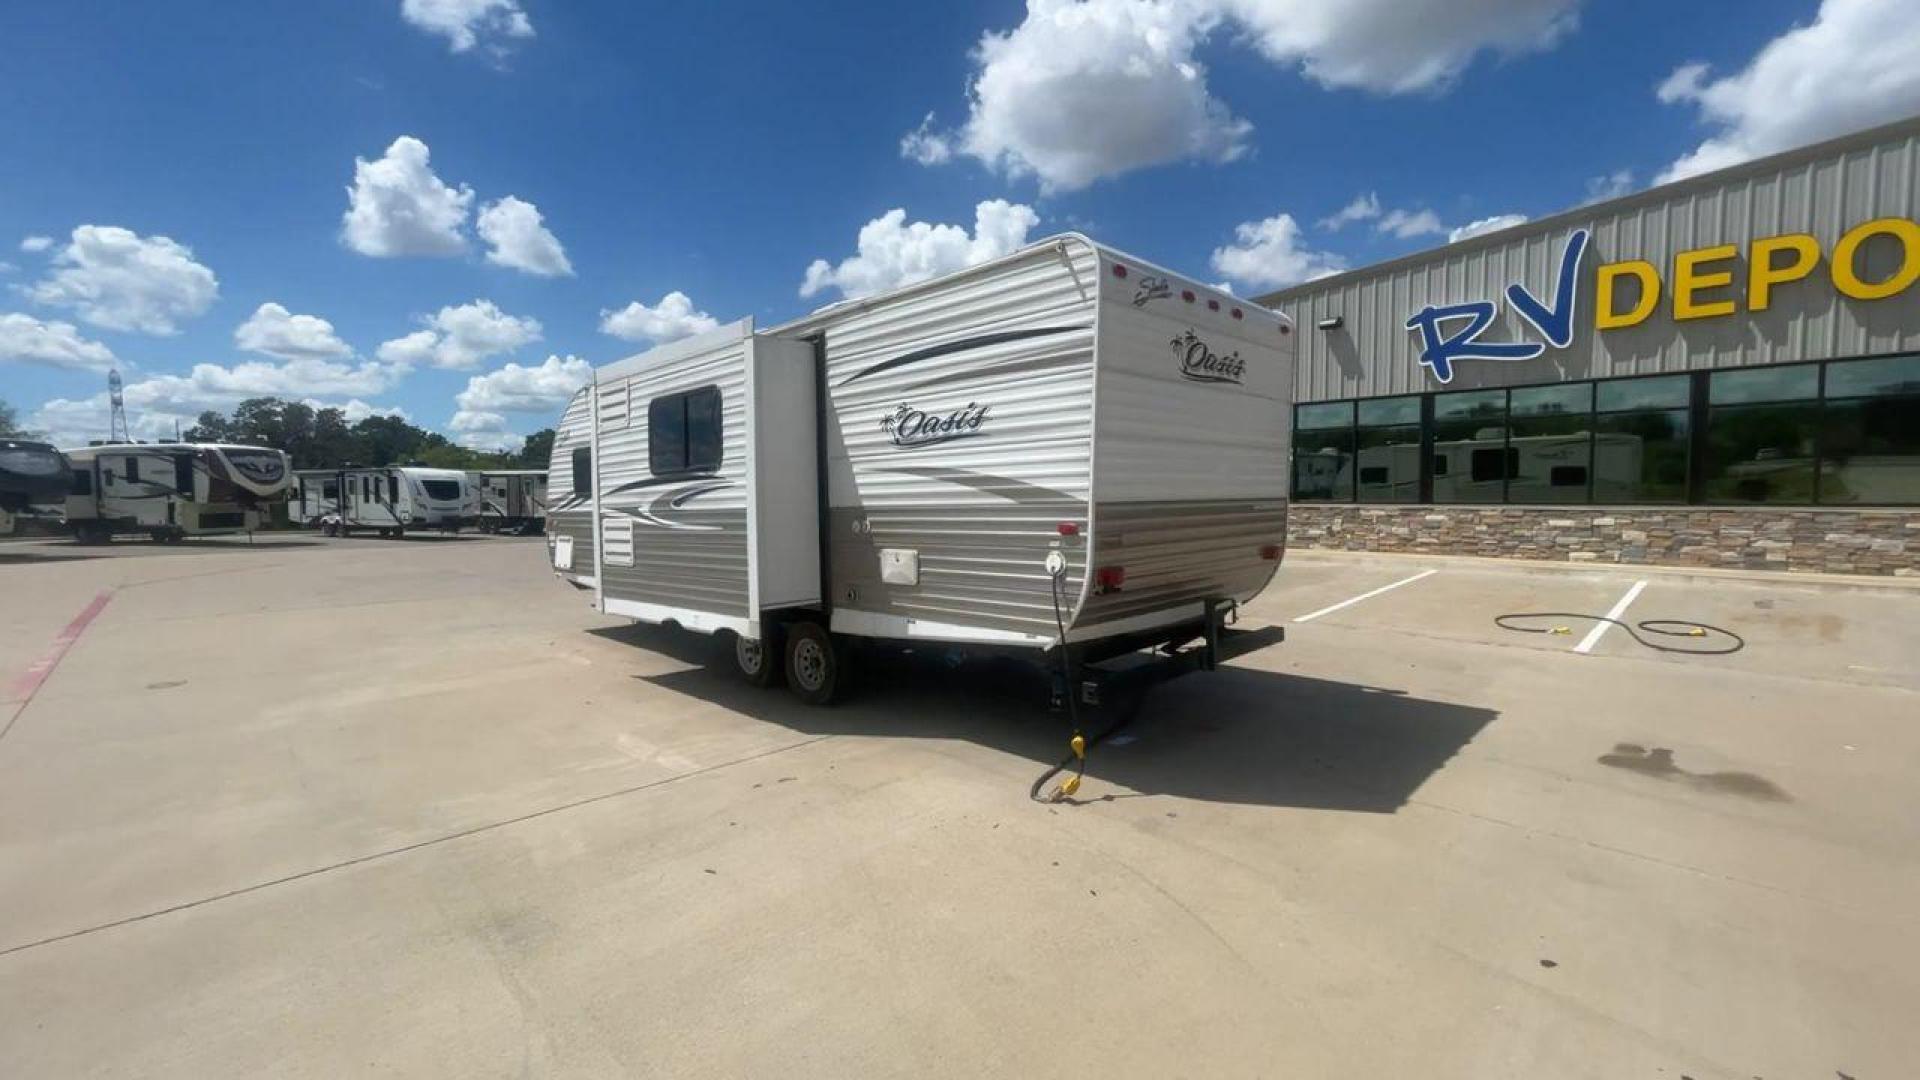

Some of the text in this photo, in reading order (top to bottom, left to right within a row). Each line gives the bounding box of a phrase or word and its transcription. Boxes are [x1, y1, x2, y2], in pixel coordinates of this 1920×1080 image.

[1405, 216, 1920, 384] RV DEPO
[1185, 341, 1246, 378] Oasis
[897, 402, 993, 438] Oasis
